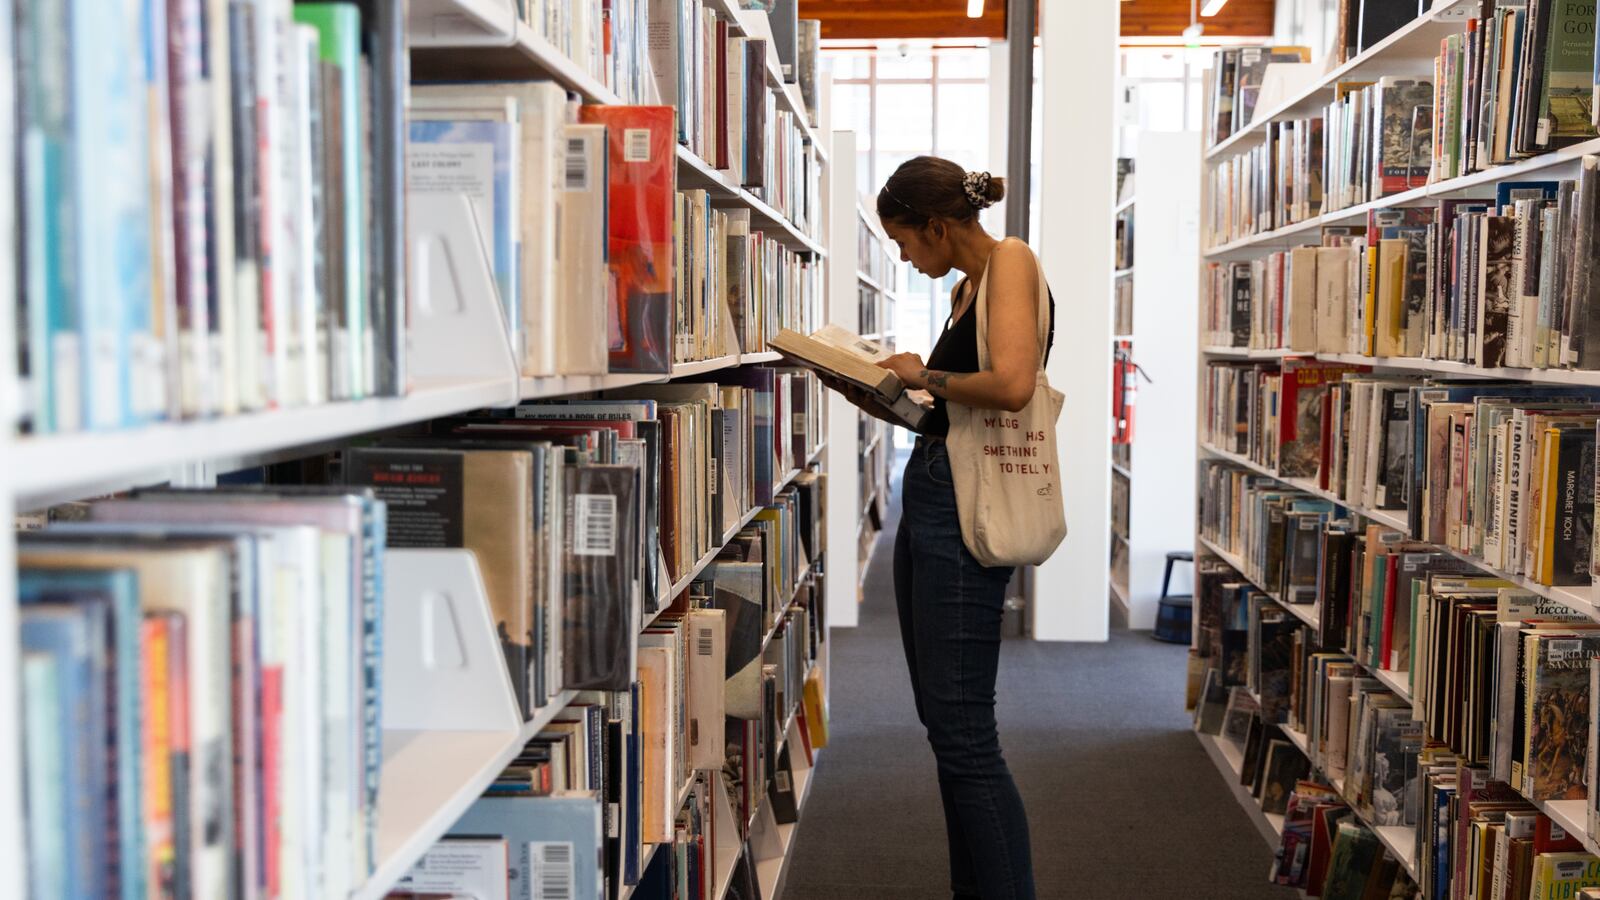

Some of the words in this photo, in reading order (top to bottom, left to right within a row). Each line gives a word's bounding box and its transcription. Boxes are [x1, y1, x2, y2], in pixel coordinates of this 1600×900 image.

[998, 418, 1019, 429] LOG
[1511, 425, 1523, 487] LONGEST
[999, 463, 1013, 473] TO
[1016, 464, 1039, 474] TELL
[1042, 464, 1052, 474] Y
[1564, 470, 1575, 513] MARGARET
[1563, 517, 1573, 542] KOCH
[1534, 606, 1569, 615] Yucca
[1549, 660, 1583, 669] SANTA
